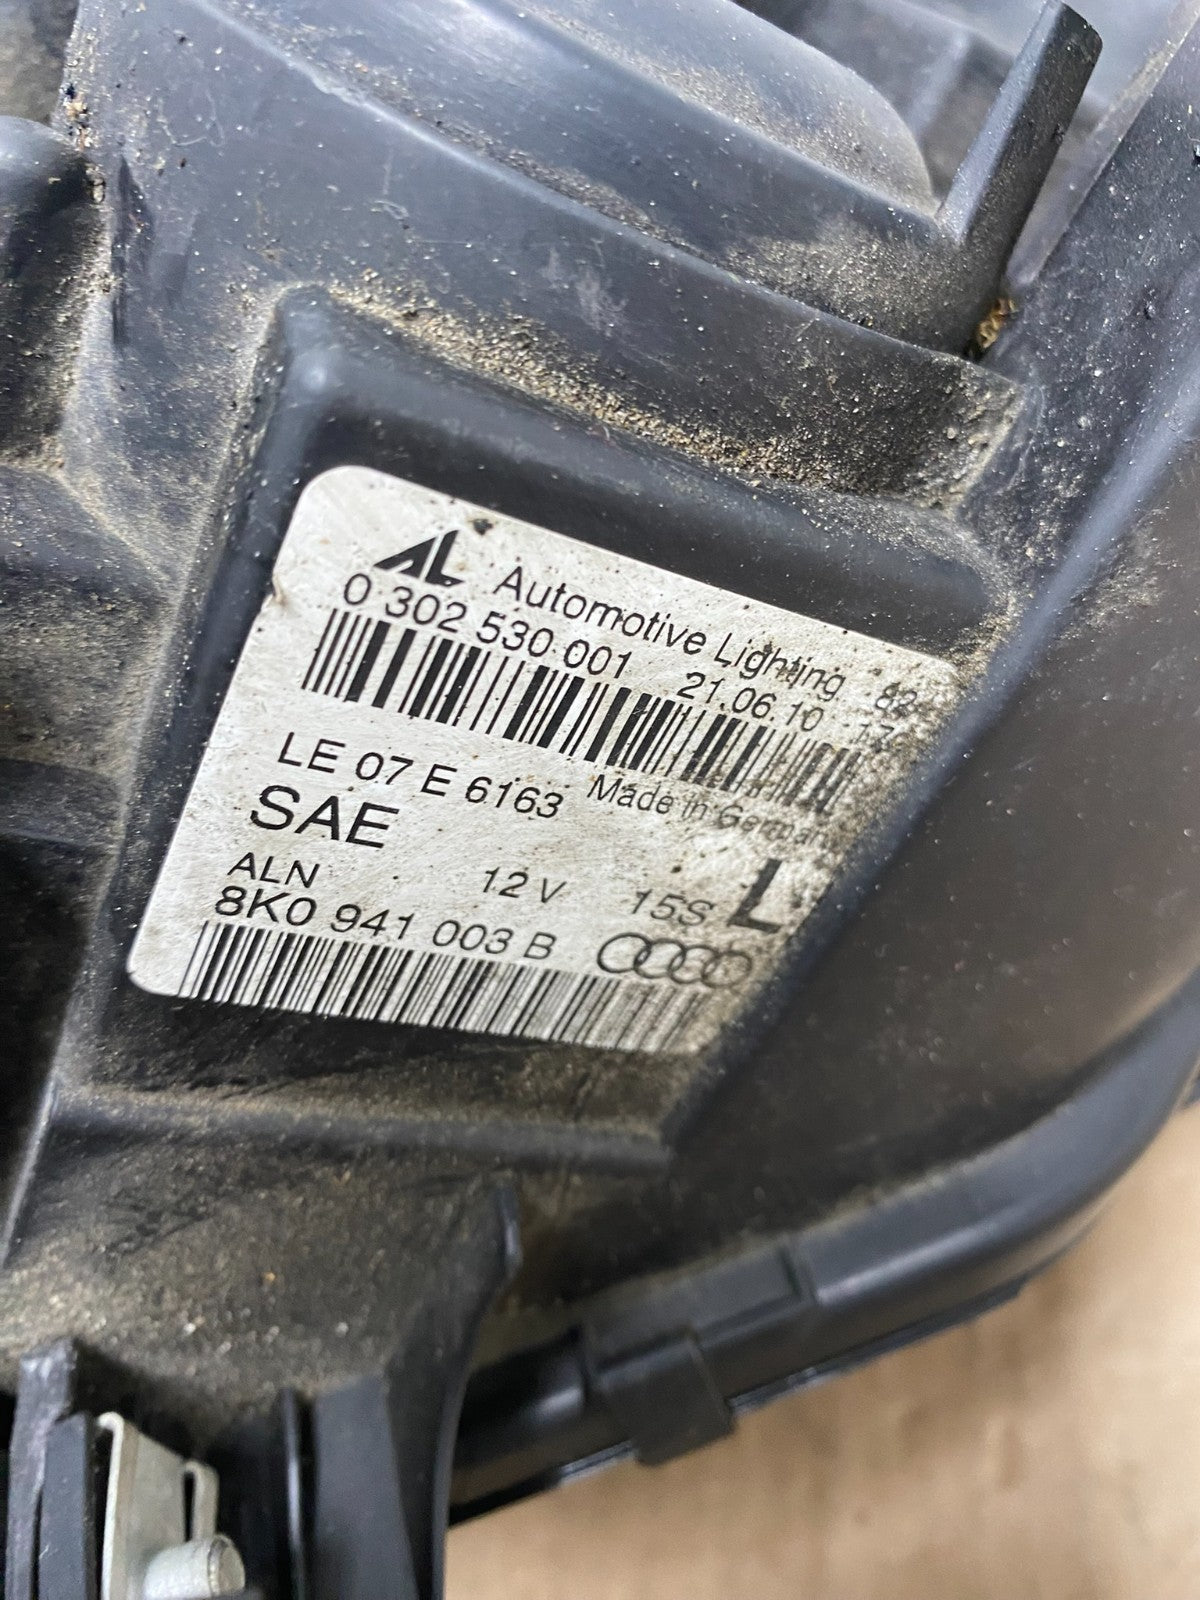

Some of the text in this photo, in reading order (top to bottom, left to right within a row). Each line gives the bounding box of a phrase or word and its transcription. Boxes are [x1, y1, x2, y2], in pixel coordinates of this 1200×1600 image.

[343, 573, 633, 679] 0 302 530 001
[493, 566, 847, 702] Automotive Lighting
[677, 672, 824, 732] 21.06.10
[277, 731, 564, 818] LE 07 E 6163
[586, 774, 672, 815] Made
[682, 794, 709, 822] in
[250, 785, 400, 849] SAE
[227, 852, 320, 888] ALN
[482, 866, 568, 903] 12 V
[726, 858, 783, 934] L
[331, 903, 415, 940] 941
[432, 920, 514, 954] 003
[523, 932, 557, 960] B
[632, 889, 714, 926] 15S
